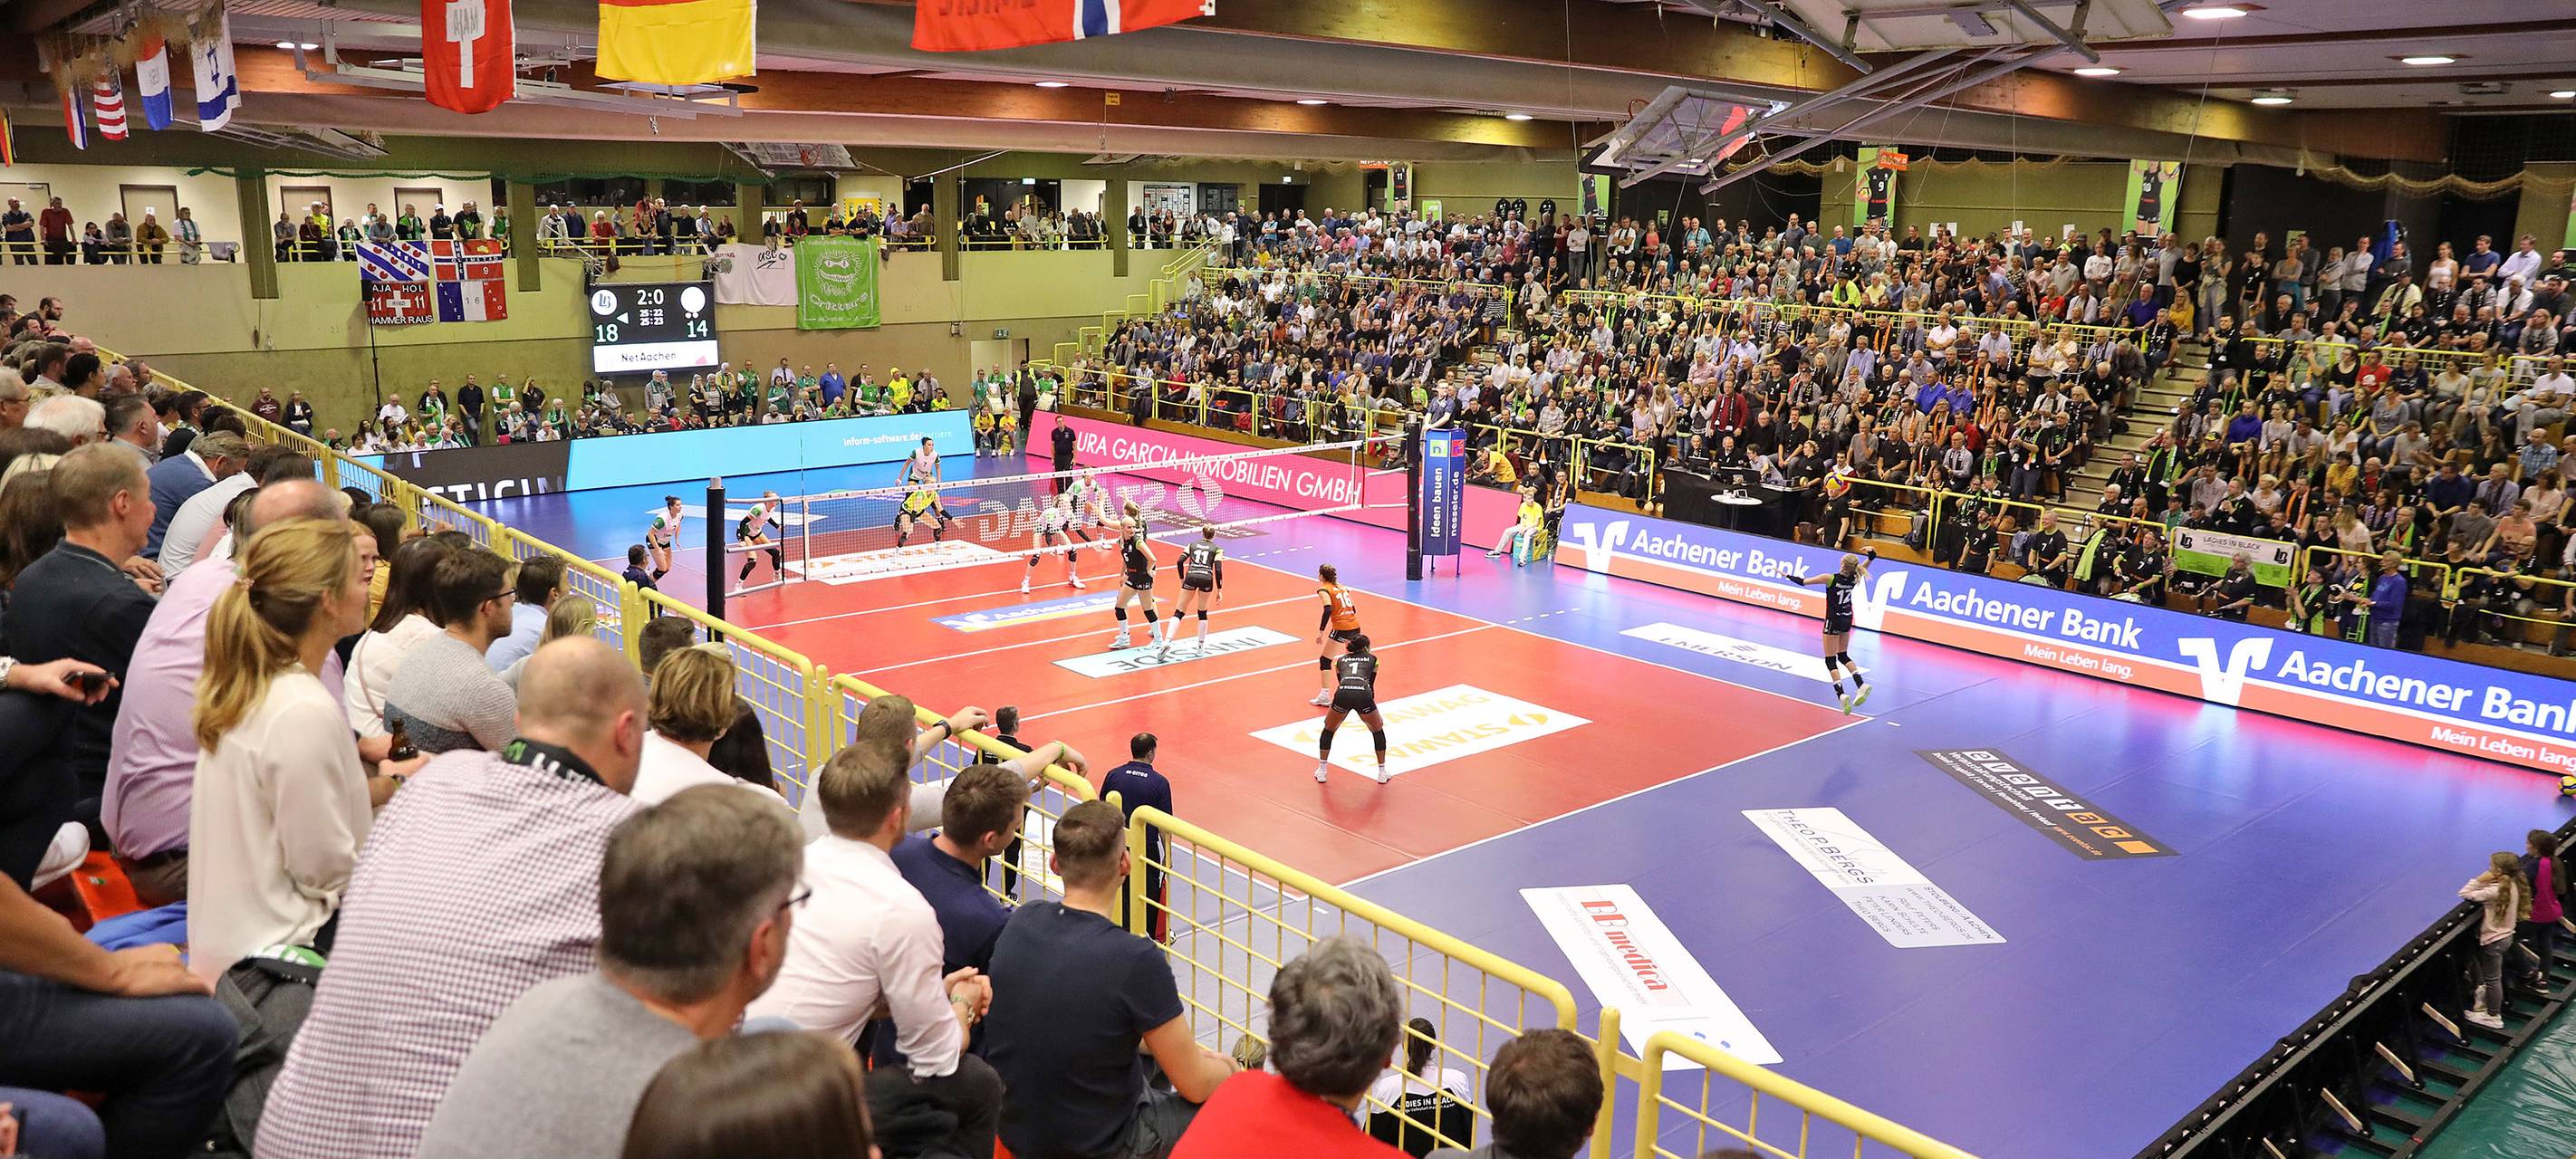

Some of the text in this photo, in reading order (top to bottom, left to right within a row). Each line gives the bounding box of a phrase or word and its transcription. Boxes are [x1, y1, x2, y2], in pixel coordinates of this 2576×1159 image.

[1879, 181, 1884, 192] 9
[758, 250, 777, 262] USC
[372, 284, 391, 292] AJA
[637, 288, 665, 305] 2:0
[415, 295, 424, 310] 11
[408, 315, 434, 323] RAUS
[639, 308, 664, 317] 25:22
[639, 317, 664, 326] 25:23
[596, 324, 619, 342] 18
[687, 320, 708, 338] 14
[1076, 431, 1362, 504] URA GARCIA IMMOBILIEN GMBH
[1431, 467, 1442, 538] ideen bauen
[1451, 471, 1460, 536] nesseler.de
[2203, 536, 2261, 551] LADIES IN BLACK
[1193, 550, 1210, 565] 11
[1631, 529, 1812, 580] Aachener Bank
[1336, 592, 1353, 608] 16
[1718, 581, 1802, 610] Mein Leben lang.
[1837, 589, 1851, 605] 12
[1910, 581, 2143, 650] Aachener Bank
[1349, 662, 1359, 674] 1
[2024, 643, 2134, 679] Mein Leben lang.
[2277, 650, 2473, 712] Aachener
[1344, 693, 1490, 733] SAWAG
[2431, 726, 2476, 748] Mein
[2480, 737, 2535, 761] Leben
[1778, 809, 1815, 835] THEO
[1821, 846, 1874, 884] BERGS
[1581, 900, 1629, 927] BB
[1604, 931, 1668, 991] medica
[1398, 1099, 1422, 1108] LDIES
[1433, 1097, 1454, 1105] BAC
